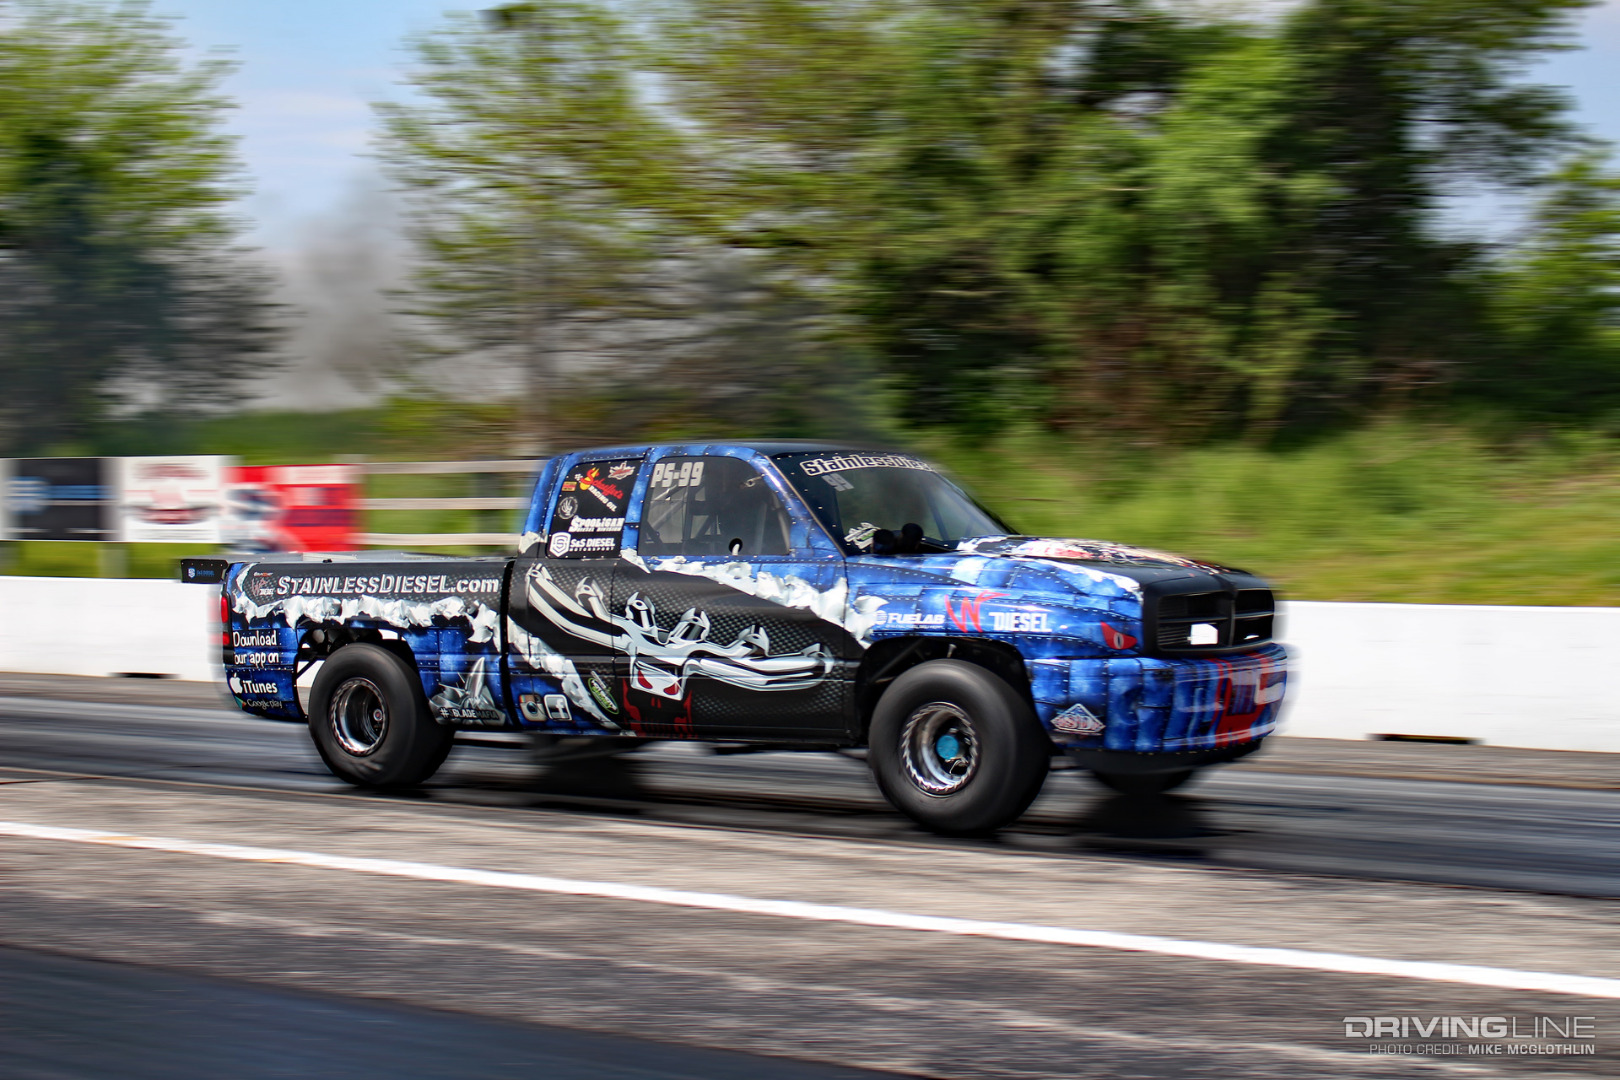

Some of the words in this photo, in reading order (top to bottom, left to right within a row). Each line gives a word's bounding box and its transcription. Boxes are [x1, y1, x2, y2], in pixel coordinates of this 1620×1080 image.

[650, 462, 705, 488] PS-99
[570, 538, 586, 548] S&S
[586, 537, 615, 547] DIESEL
[887, 612, 945, 625] FUELAB
[988, 612, 1052, 633] DIESEL
[233, 629, 277, 647] Download
[234, 653, 247, 665] our
[249, 651, 266, 668] app
[268, 652, 279, 663] on
[242, 680, 278, 694] iTunes
